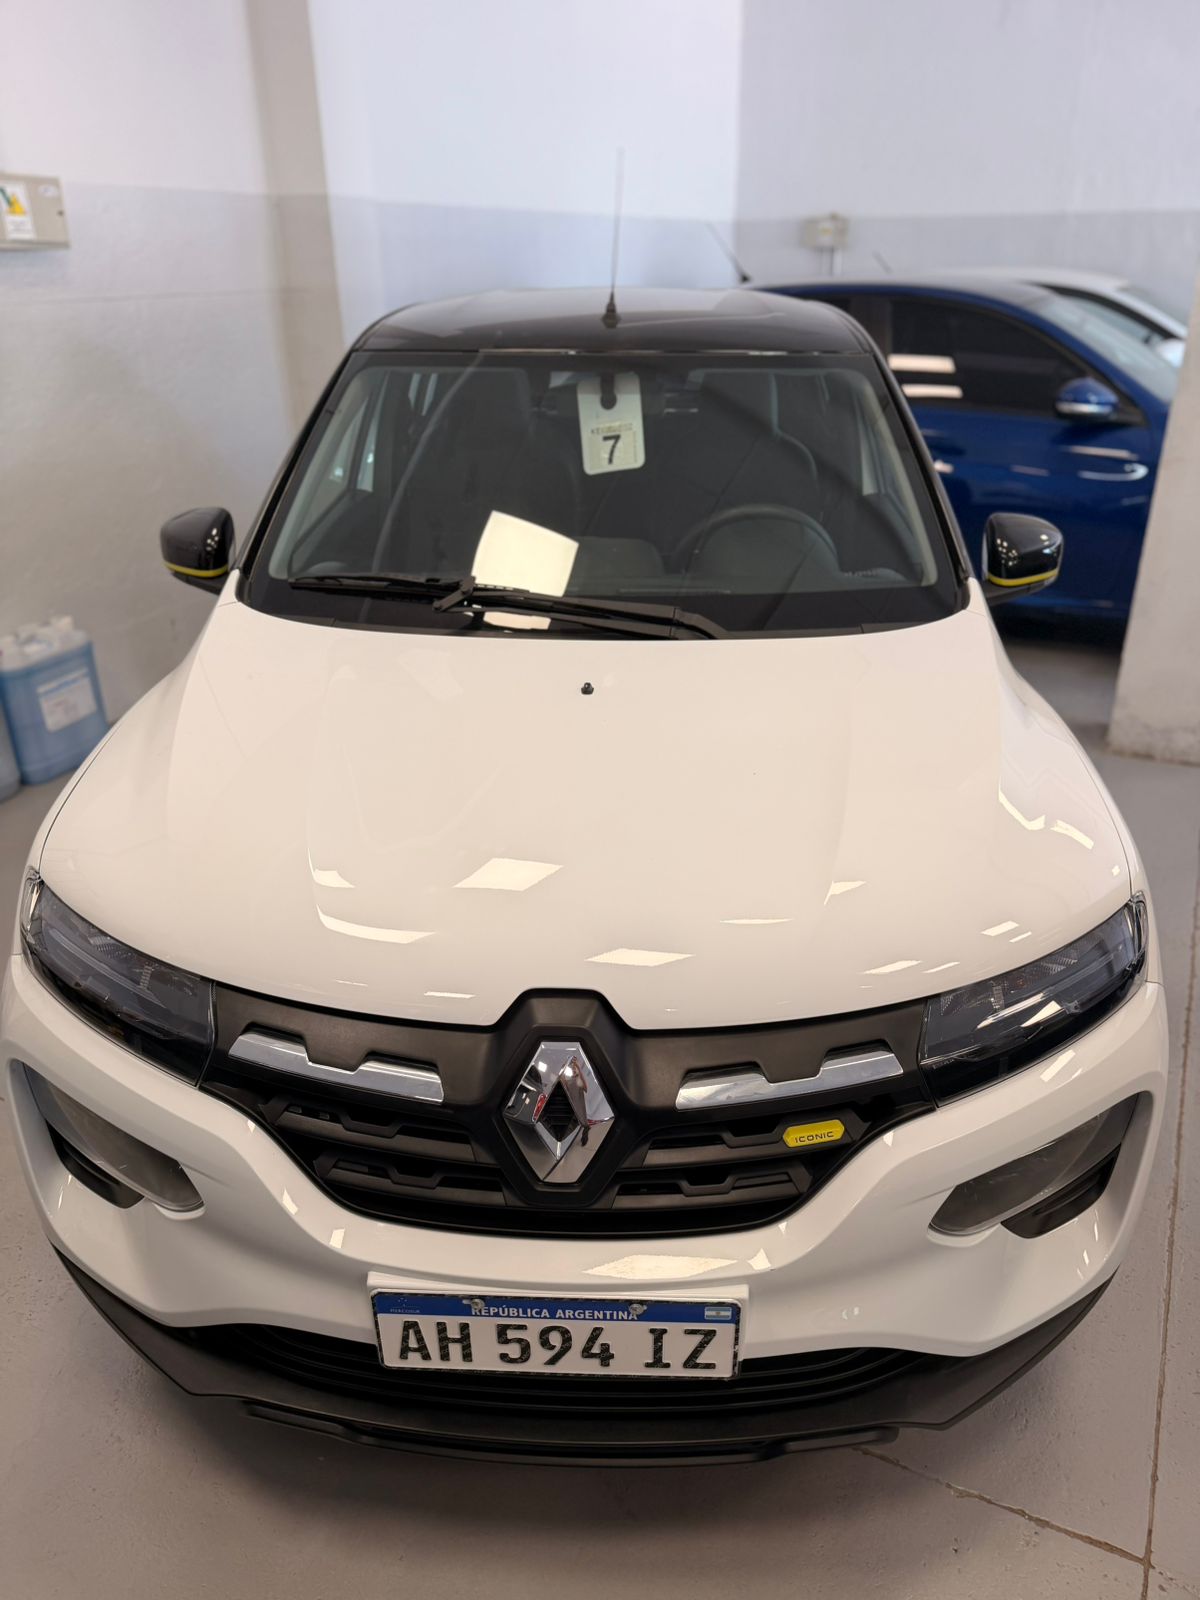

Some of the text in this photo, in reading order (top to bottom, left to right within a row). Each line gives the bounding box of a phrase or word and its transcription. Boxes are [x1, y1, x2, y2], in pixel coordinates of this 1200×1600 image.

[602, 434, 621, 465] 7
[795, 1131, 834, 1143] ICONIC
[471, 1305, 638, 1320] REPÚBLICA ARGENTINA
[399, 1320, 717, 1370] AH 594 IZ
